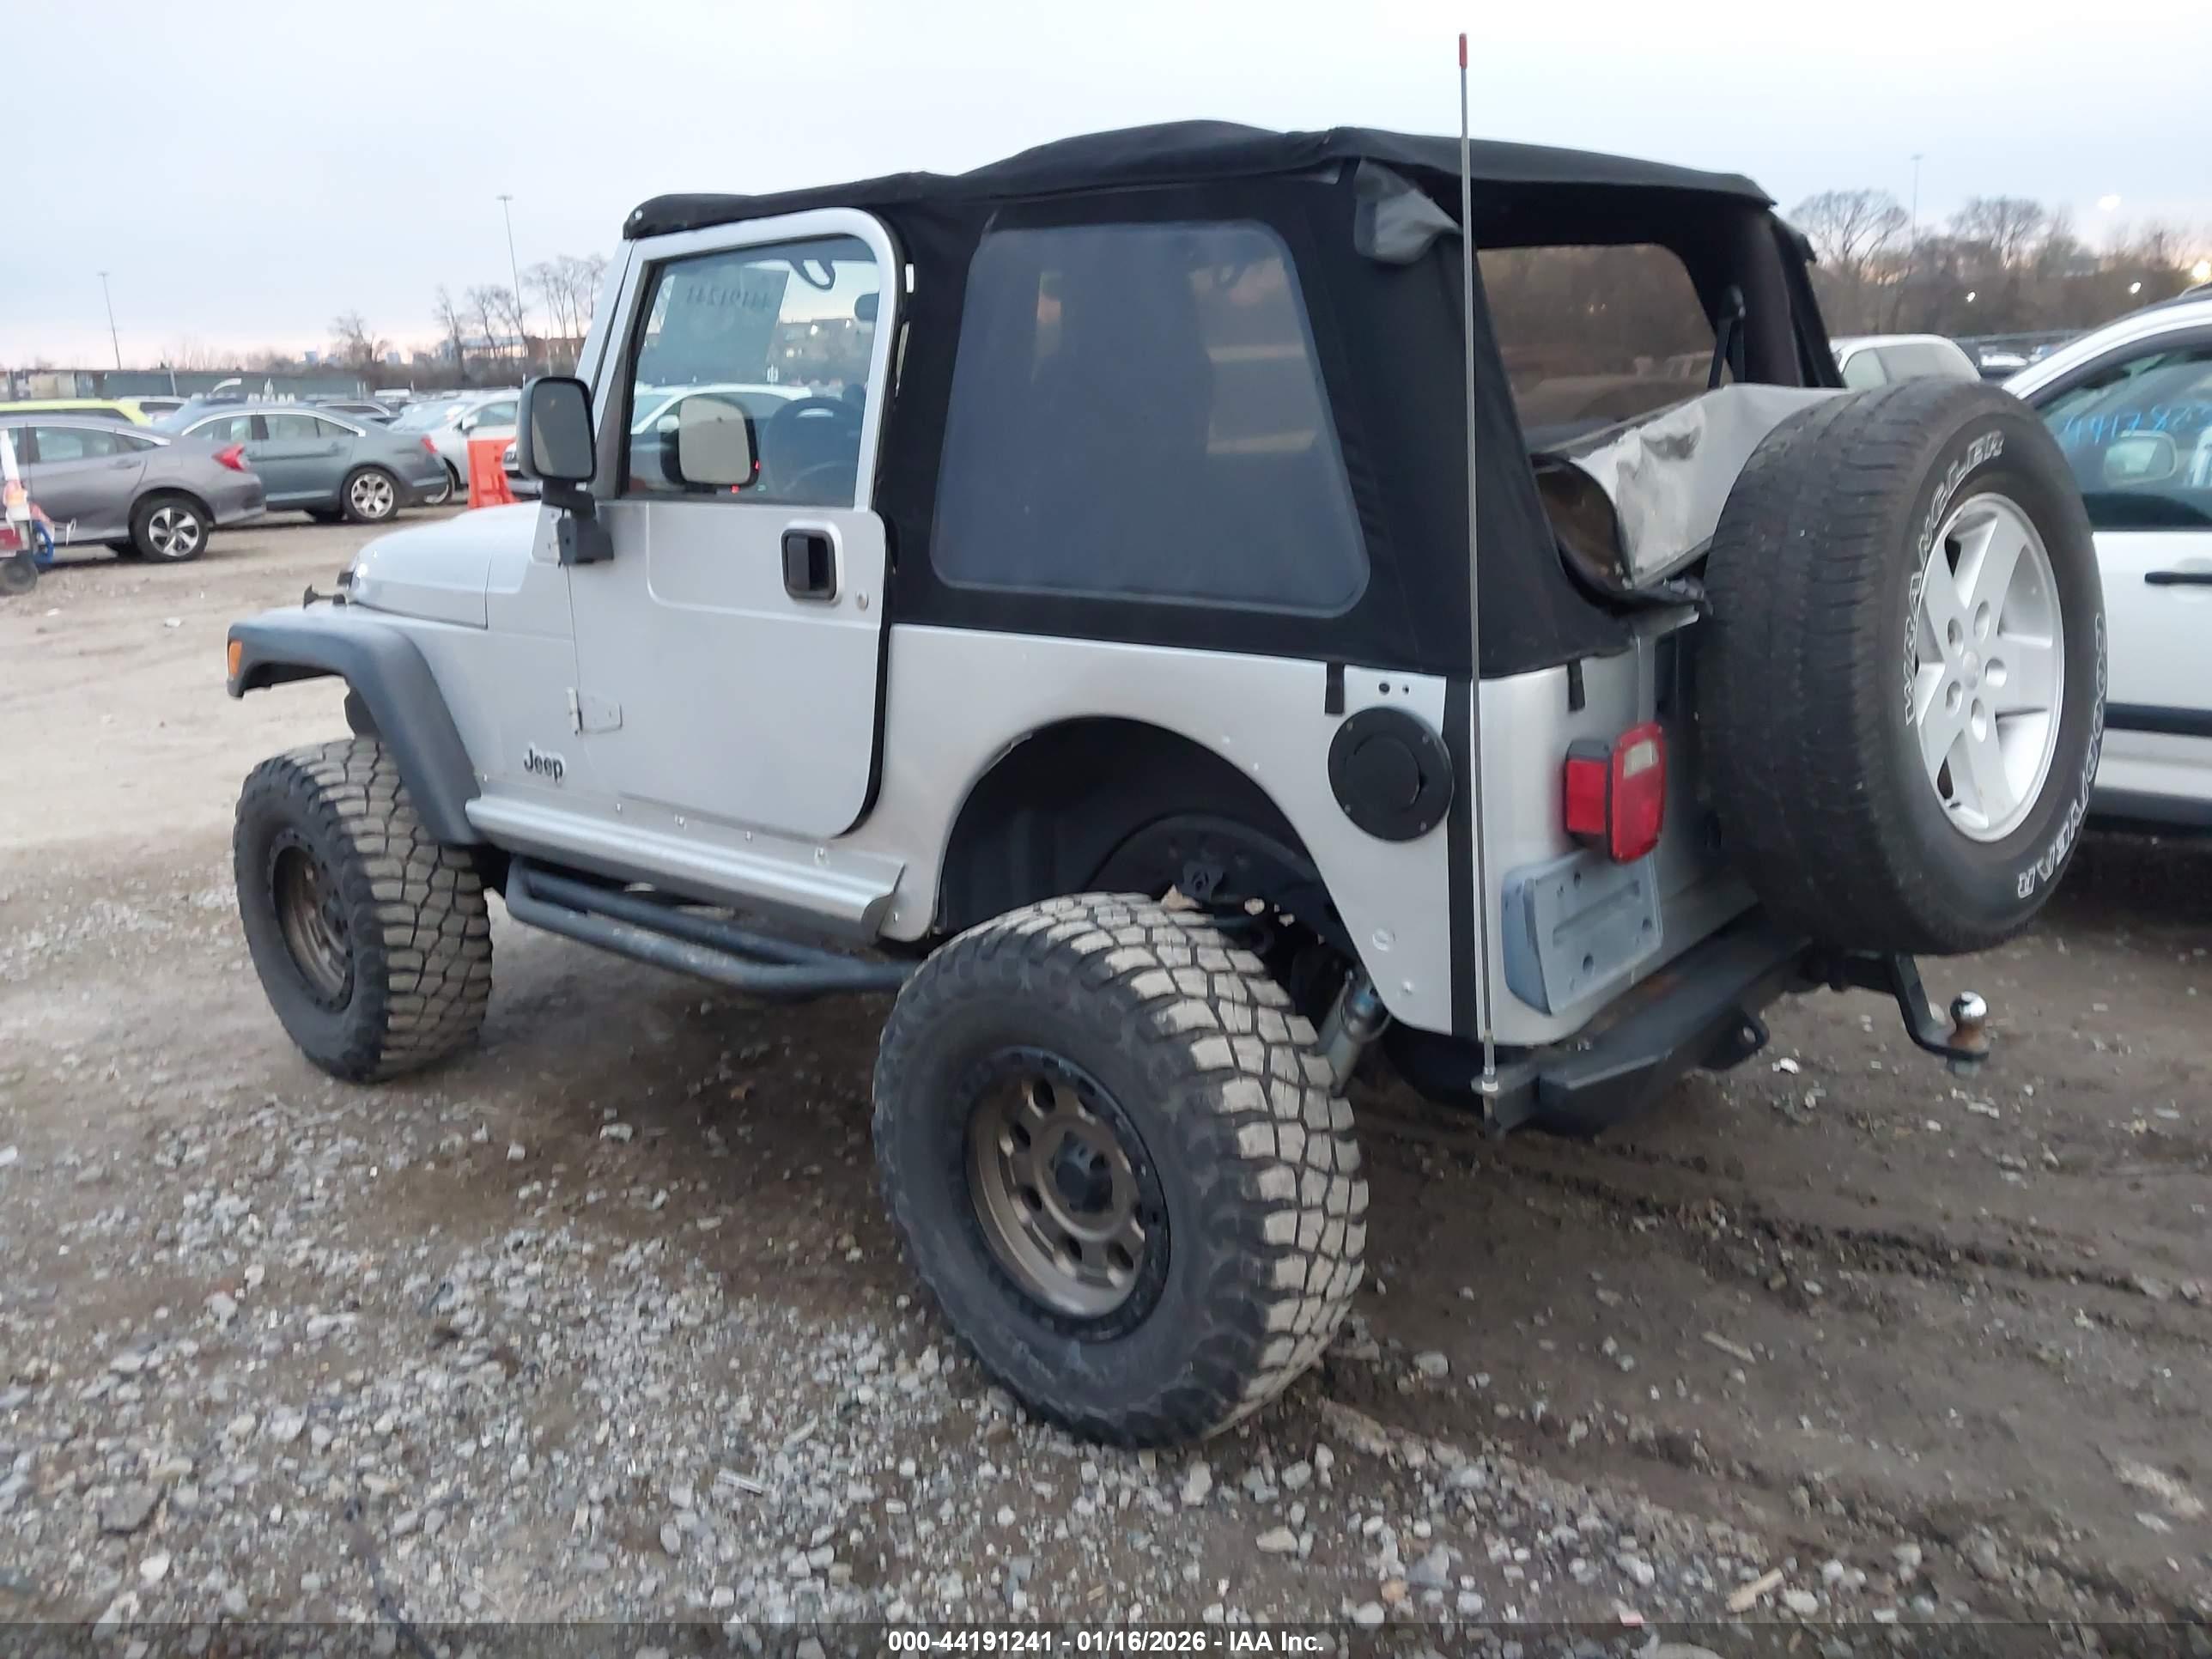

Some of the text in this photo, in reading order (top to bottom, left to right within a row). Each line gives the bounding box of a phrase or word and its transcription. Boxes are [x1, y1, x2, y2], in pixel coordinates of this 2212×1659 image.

[1903, 429, 2005, 726] WRANGLER
[523, 745, 564, 784] Jeep
[2017, 612, 2105, 898] GOODYEAR
